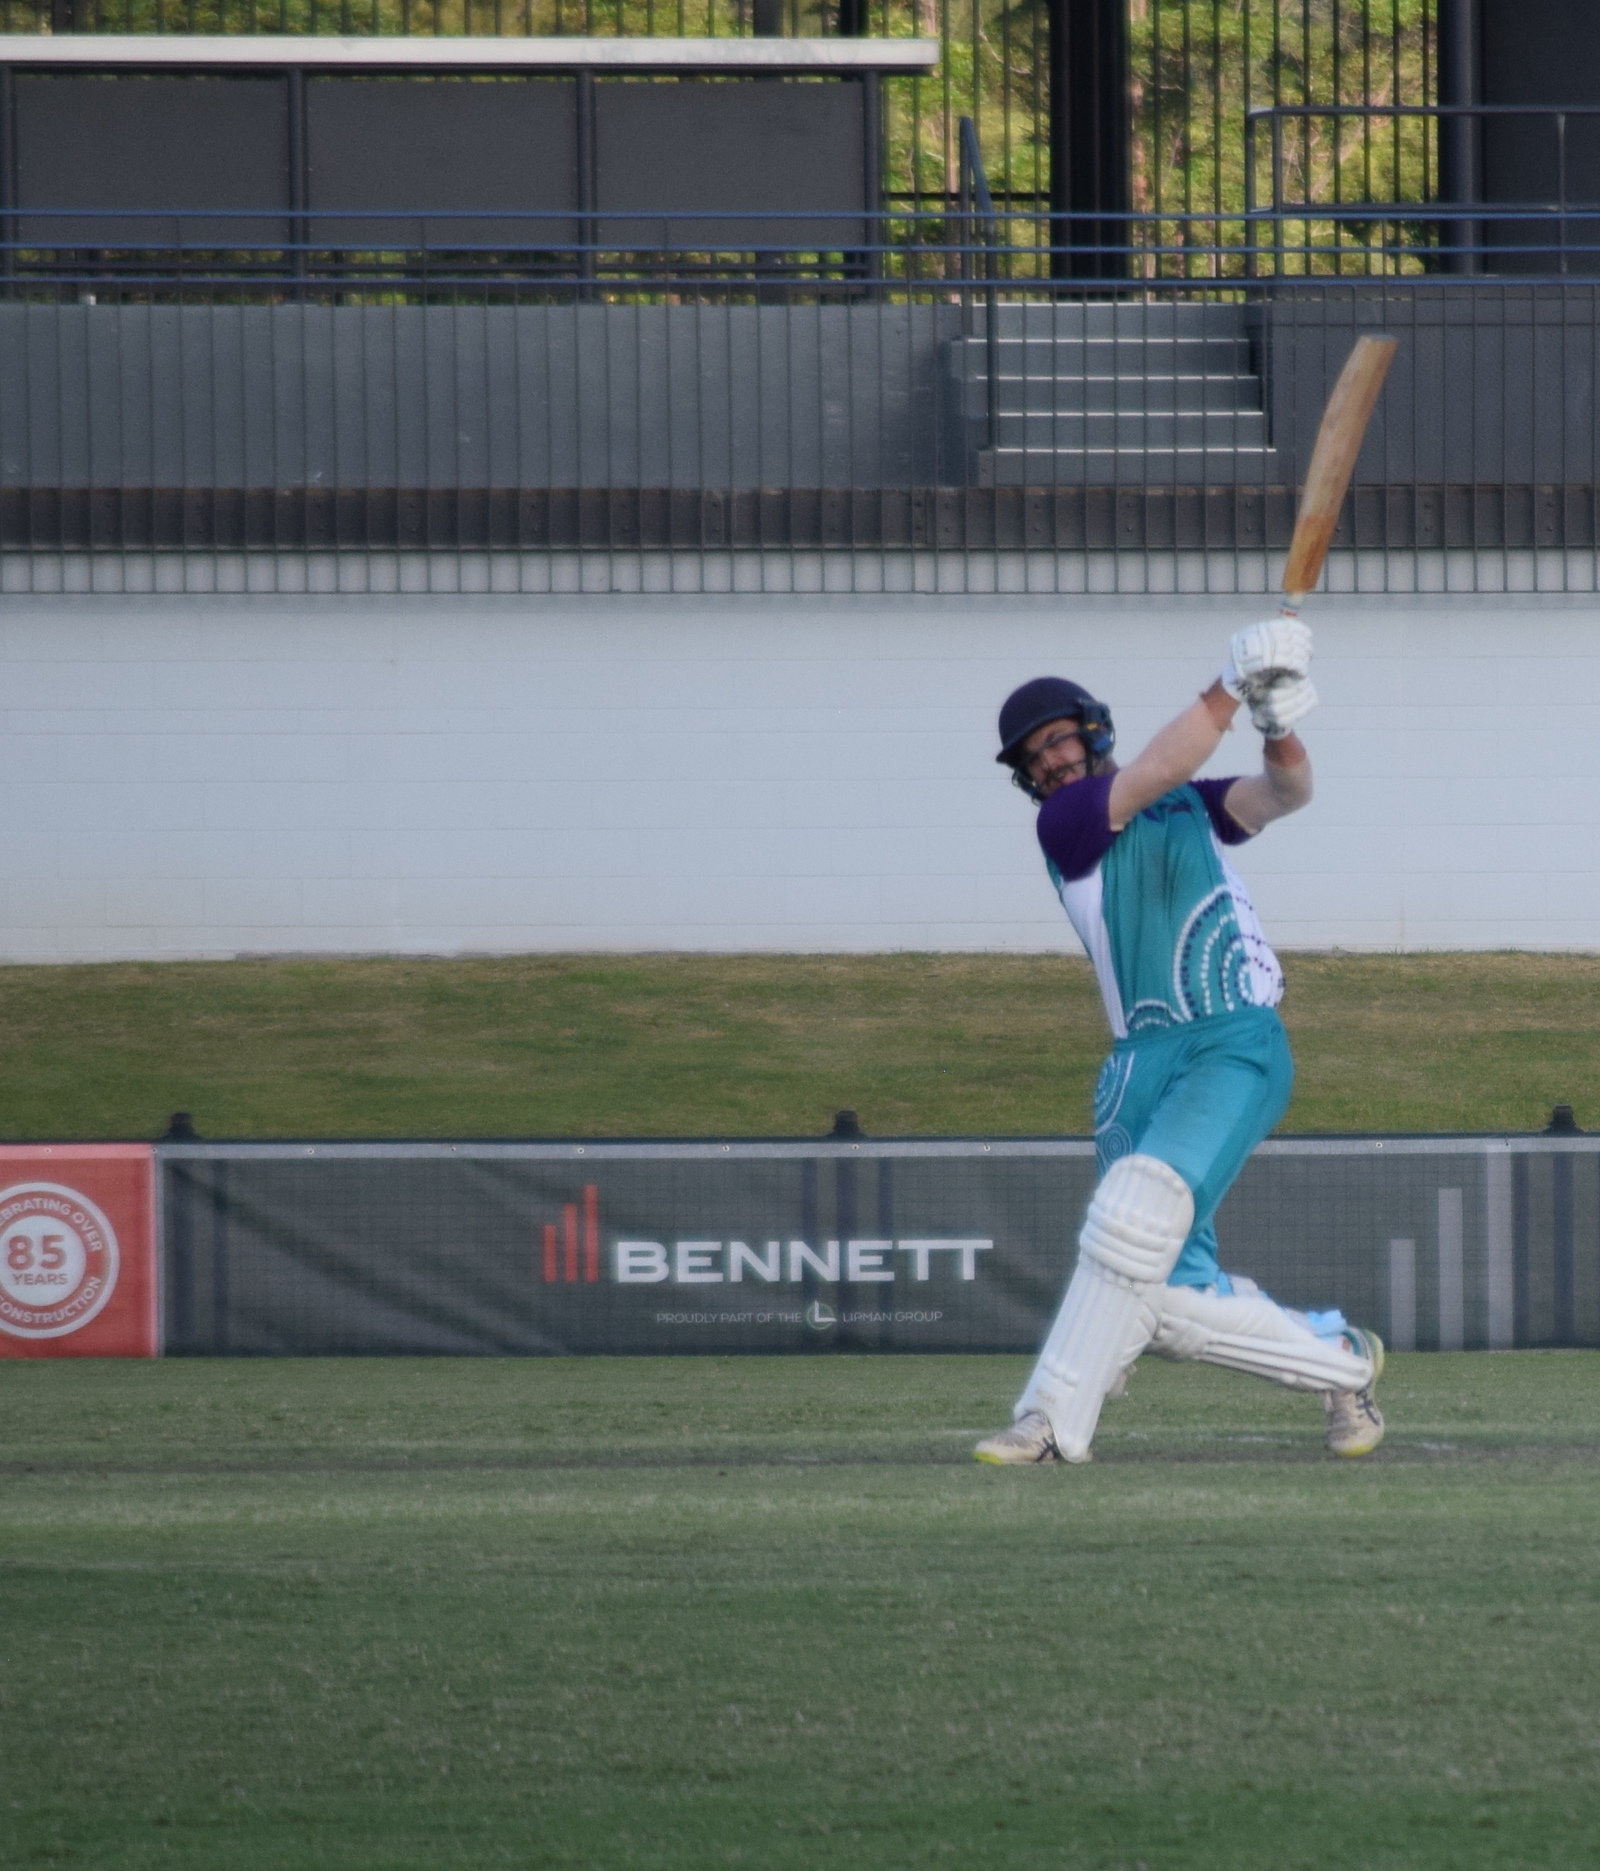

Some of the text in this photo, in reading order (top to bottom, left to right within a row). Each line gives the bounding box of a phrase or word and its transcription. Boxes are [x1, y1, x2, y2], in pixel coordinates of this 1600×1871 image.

[72, 1211, 104, 1252] OVER
[7, 1234, 67, 1271] 85
[617, 1240, 993, 1283] BENNETT
[12, 1273, 68, 1286] YEARS
[0, 1276, 102, 1324] ONSTRUCTION
[656, 1312, 718, 1324] PROUDLY
[720, 1312, 753, 1323] PART
[756, 1312, 775, 1323] OF
[777, 1312, 803, 1323] THE
[842, 1311, 892, 1323] LIPMAN
[894, 1310, 943, 1322] GROUP
